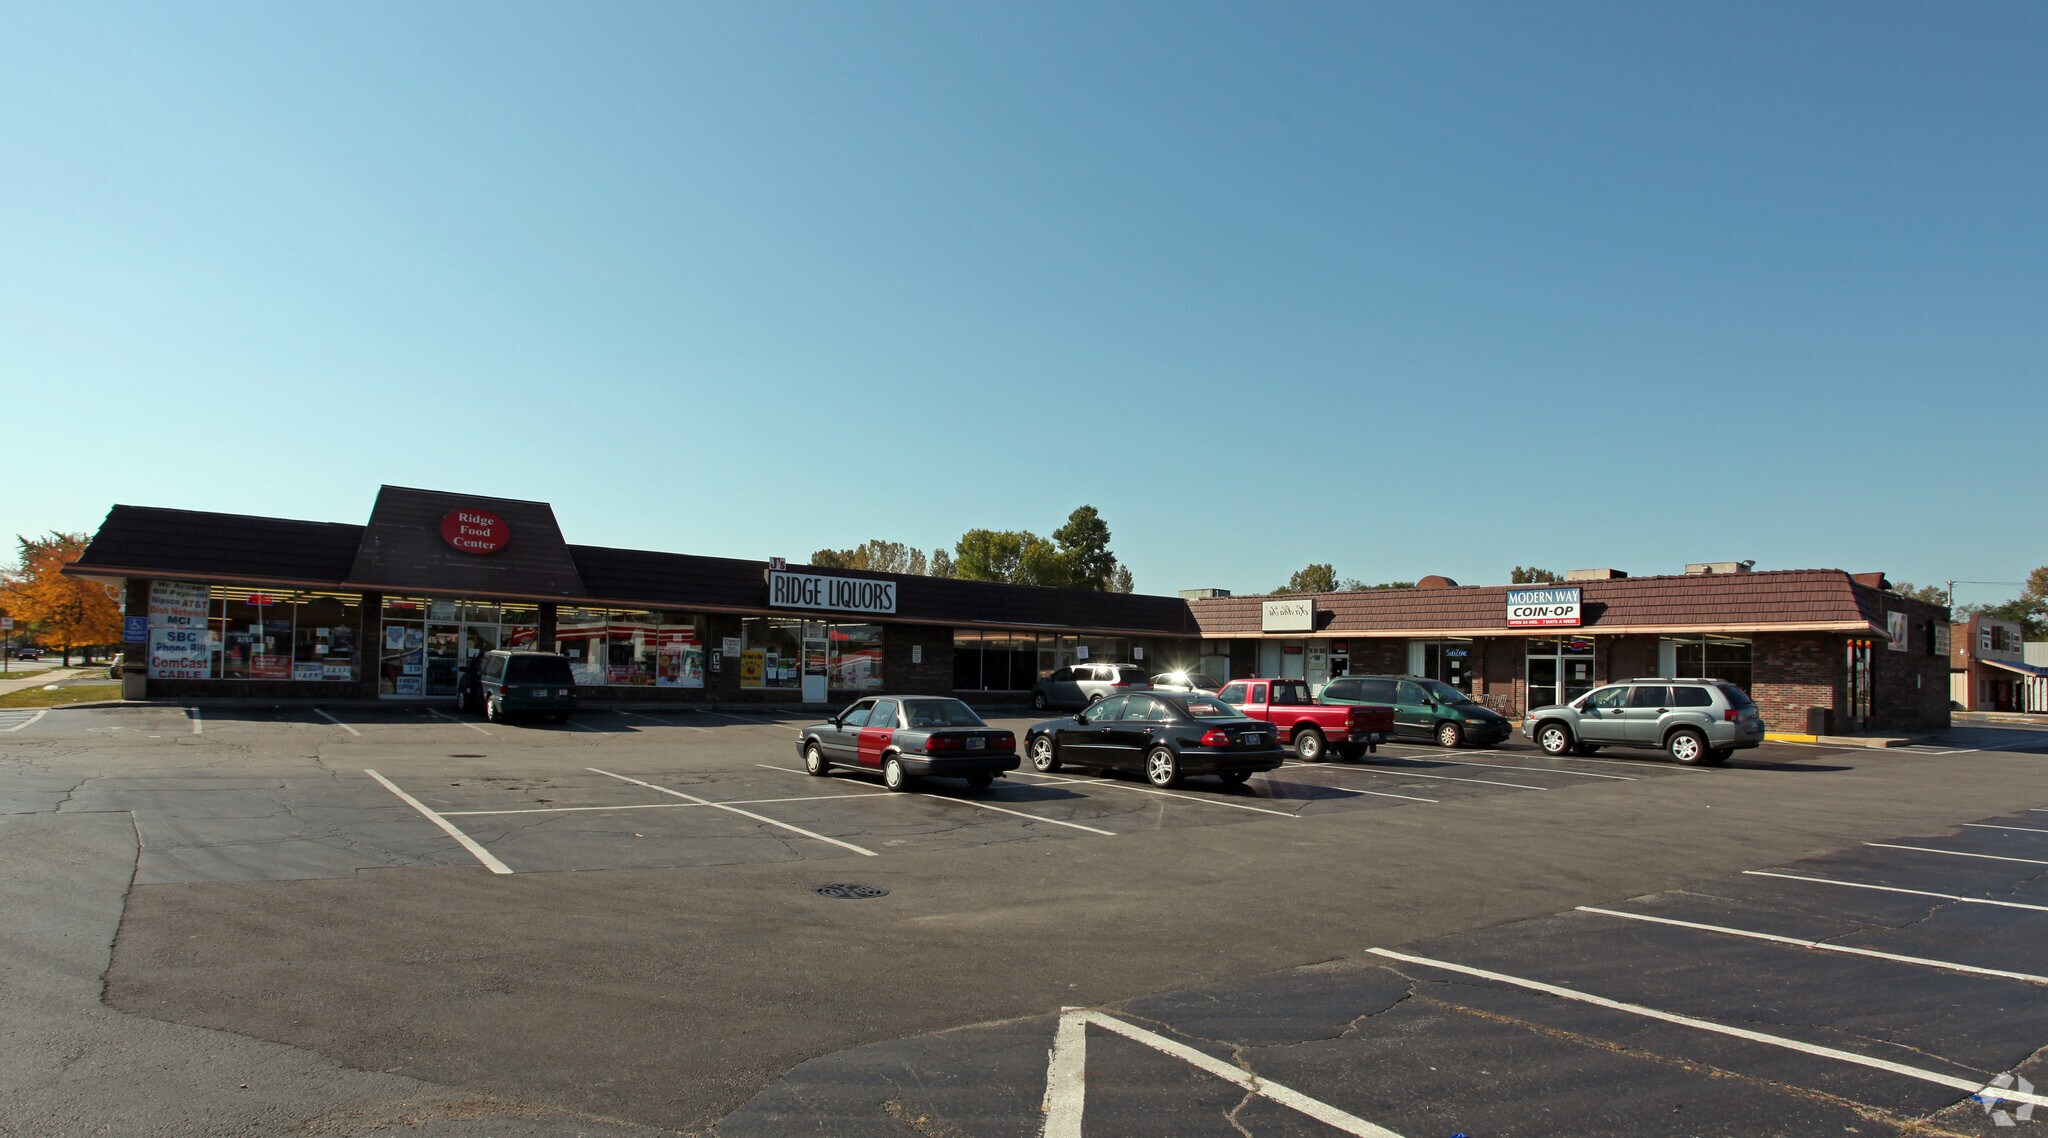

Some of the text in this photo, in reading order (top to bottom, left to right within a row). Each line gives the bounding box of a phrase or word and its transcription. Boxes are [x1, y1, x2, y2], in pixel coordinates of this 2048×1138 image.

[458, 513, 494, 526] Ridge
[460, 525, 491, 537] Food
[453, 537, 496, 549] Center
[770, 558, 785, 570] J's
[775, 576, 892, 610] RIDGE LIQUORS
[1508, 590, 1579, 604] MODERN WAY
[150, 606, 208, 617] Dish Network
[1514, 606, 1573, 617] COIN-OP
[167, 616, 191, 624] MCI
[167, 632, 196, 642] SBC
[156, 643, 187, 652] Phone
[152, 657, 208, 668] ComCast
